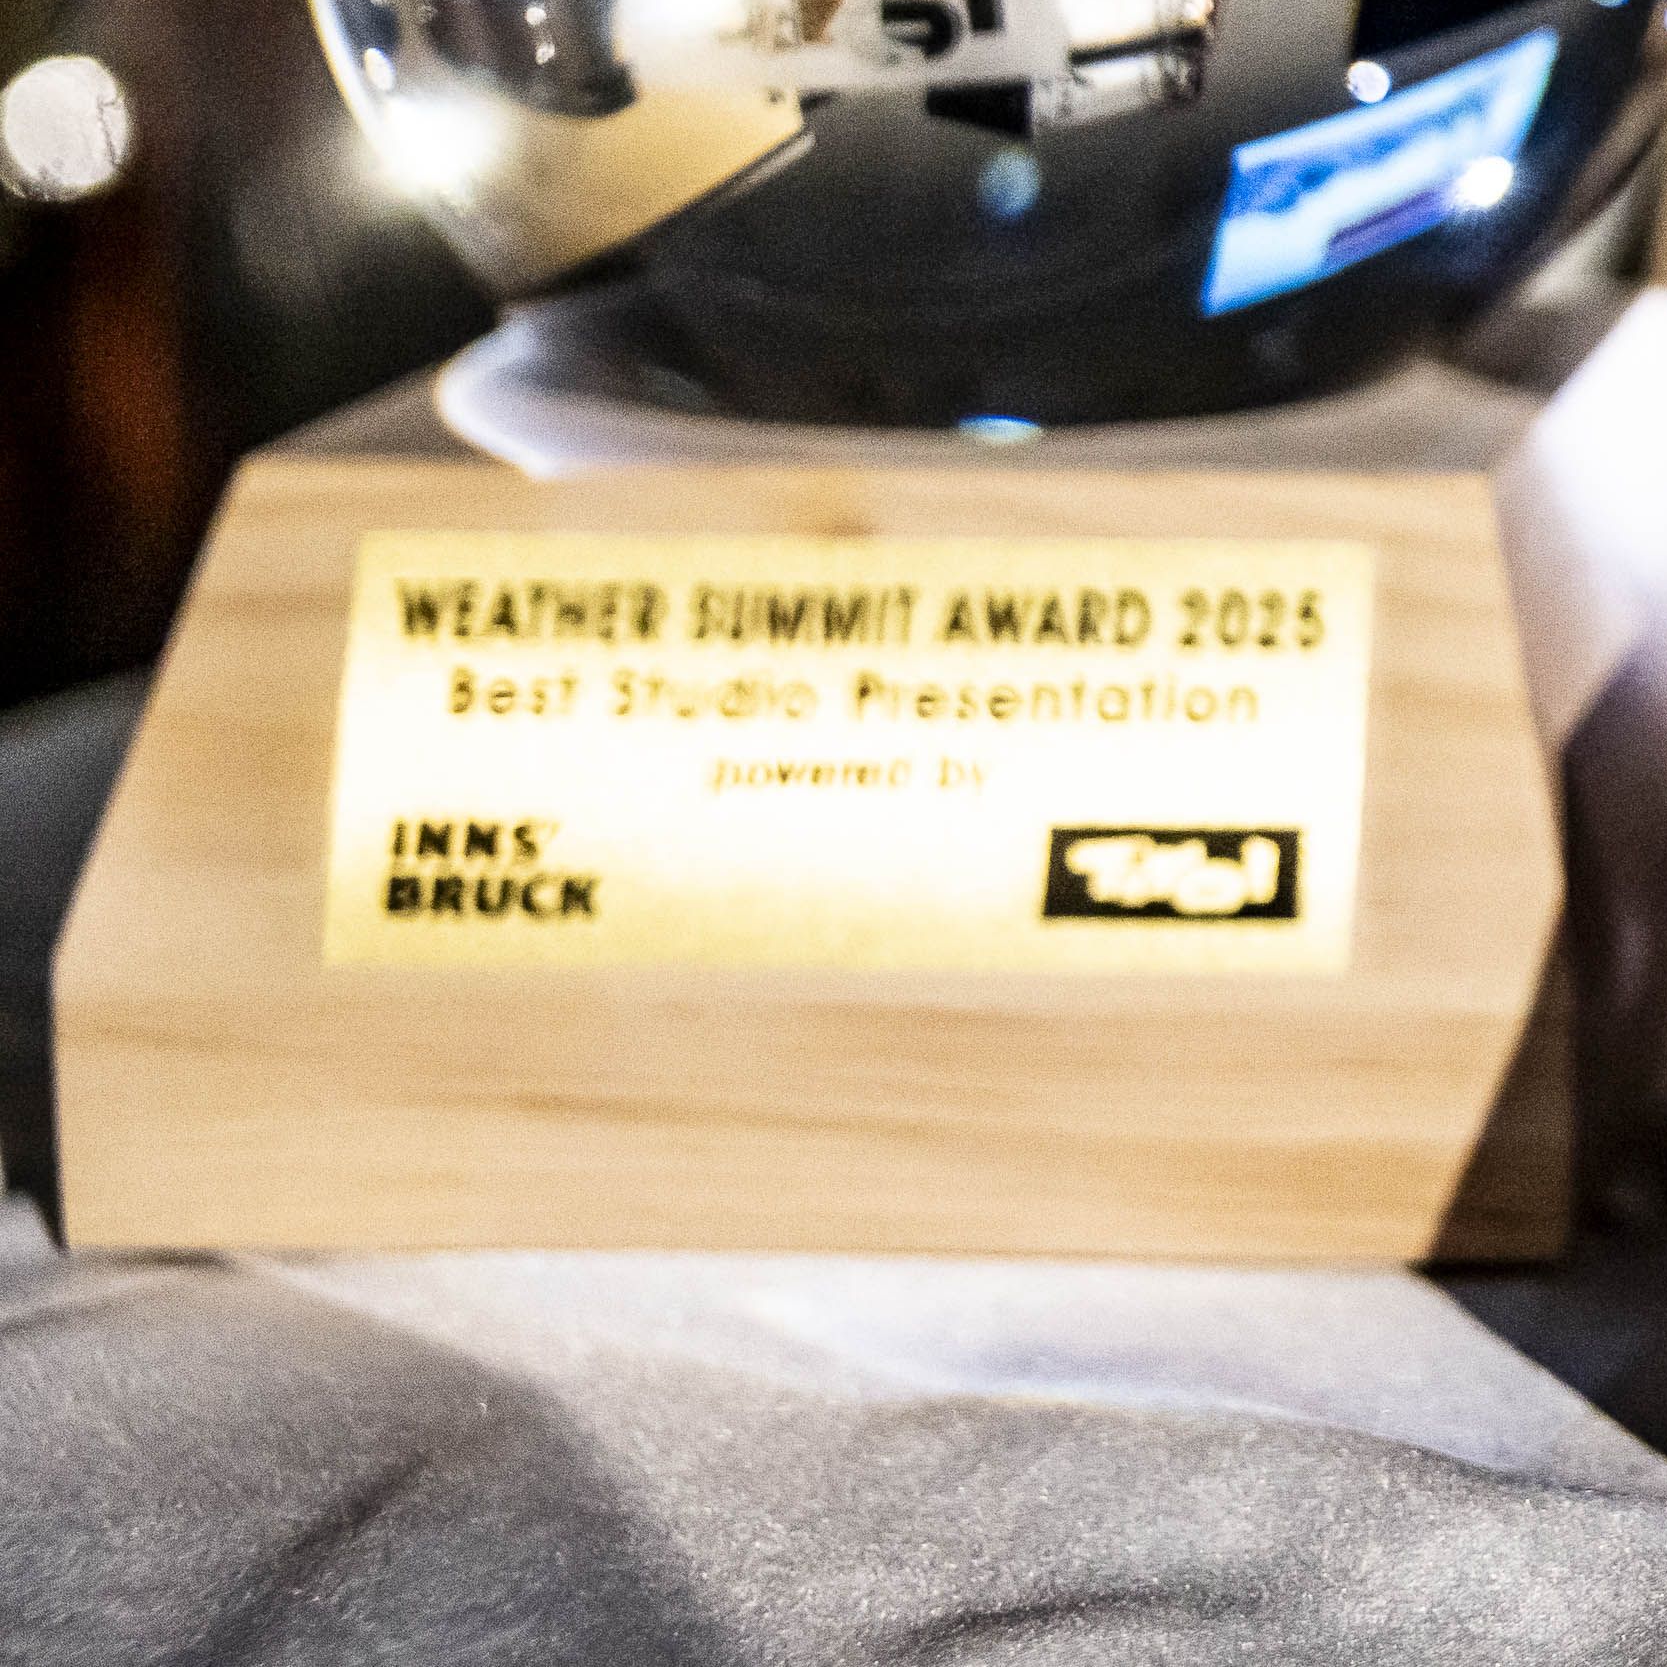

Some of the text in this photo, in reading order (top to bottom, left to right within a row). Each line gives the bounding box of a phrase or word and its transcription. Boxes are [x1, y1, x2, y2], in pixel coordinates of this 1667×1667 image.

[396, 580, 1324, 648] WEATHER SUMMIT AWARD 2025
[448, 666, 581, 716] Best
[857, 672, 1260, 723] Presentation
[383, 872, 599, 918] BRUCK
